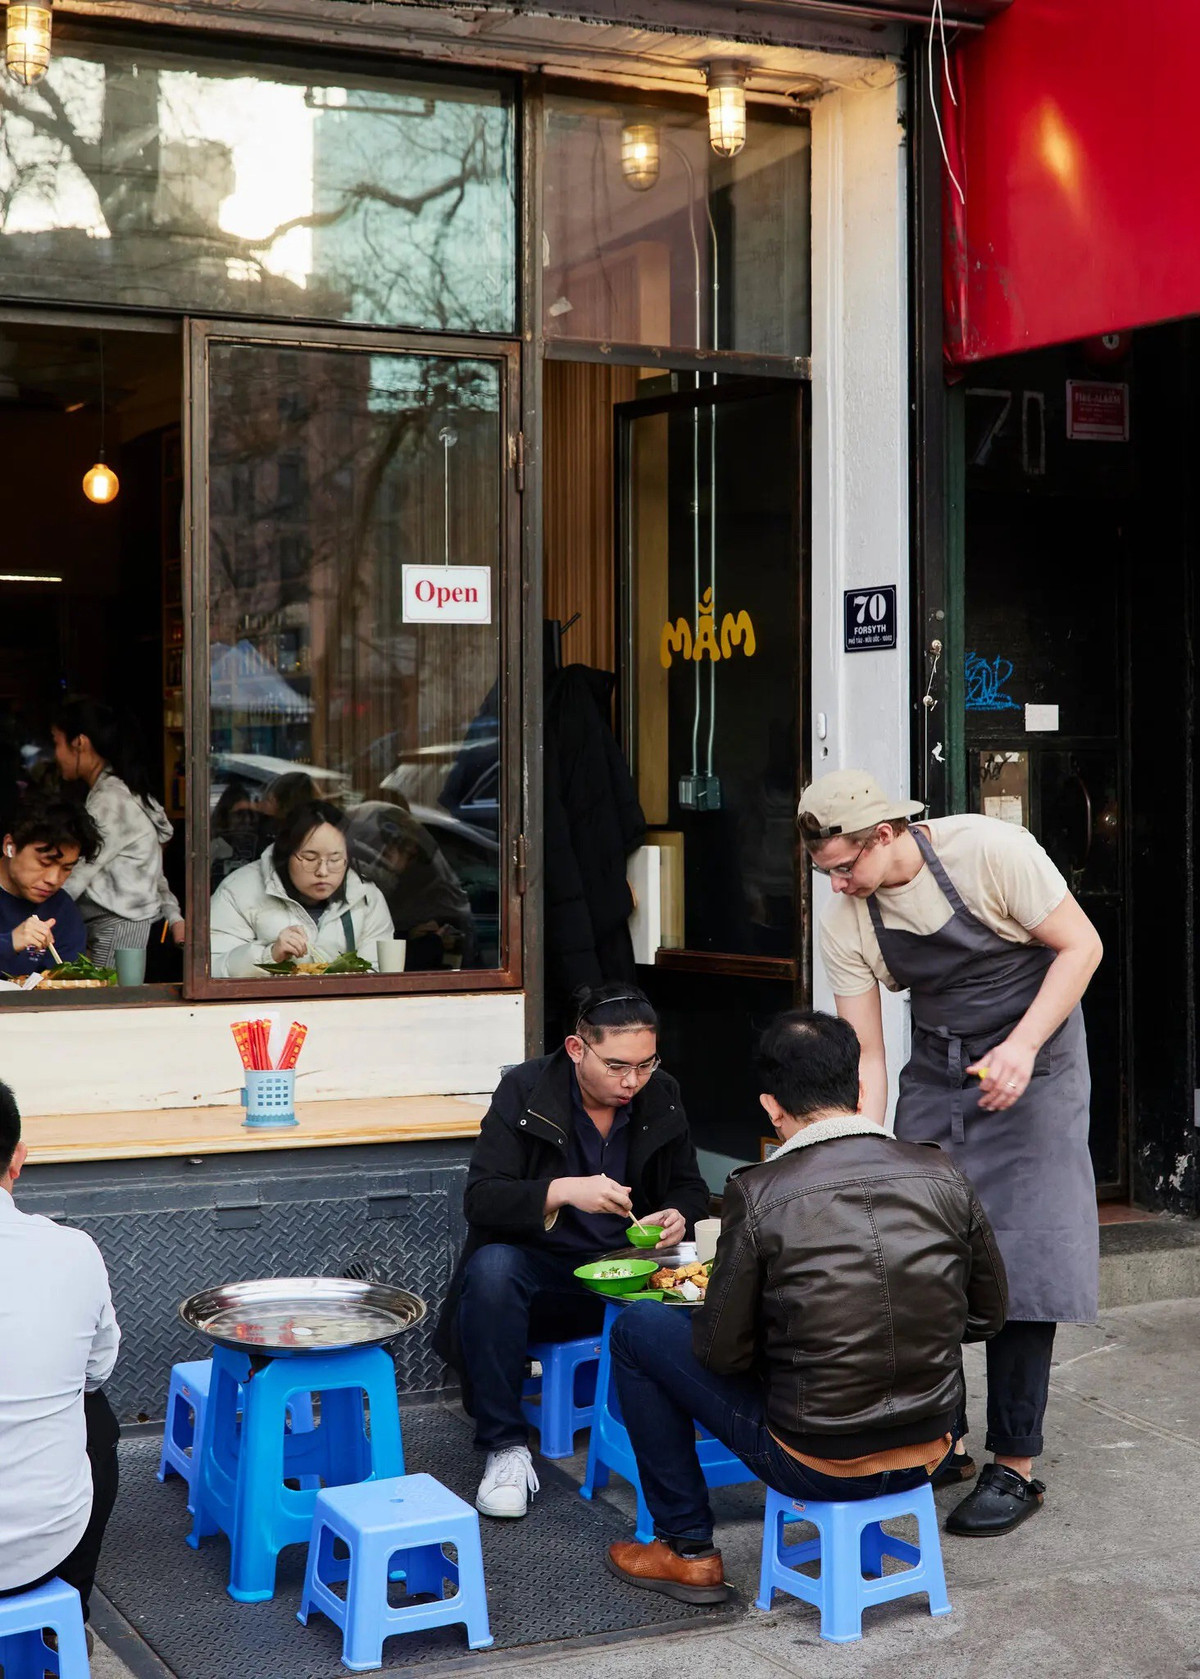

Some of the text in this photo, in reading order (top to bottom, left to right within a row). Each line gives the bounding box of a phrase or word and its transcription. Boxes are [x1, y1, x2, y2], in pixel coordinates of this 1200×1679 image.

[965, 388, 1046, 475] 70
[415, 580, 478, 608] Open
[853, 593, 887, 624] 70
[854, 624, 887, 635] FORSYTH
